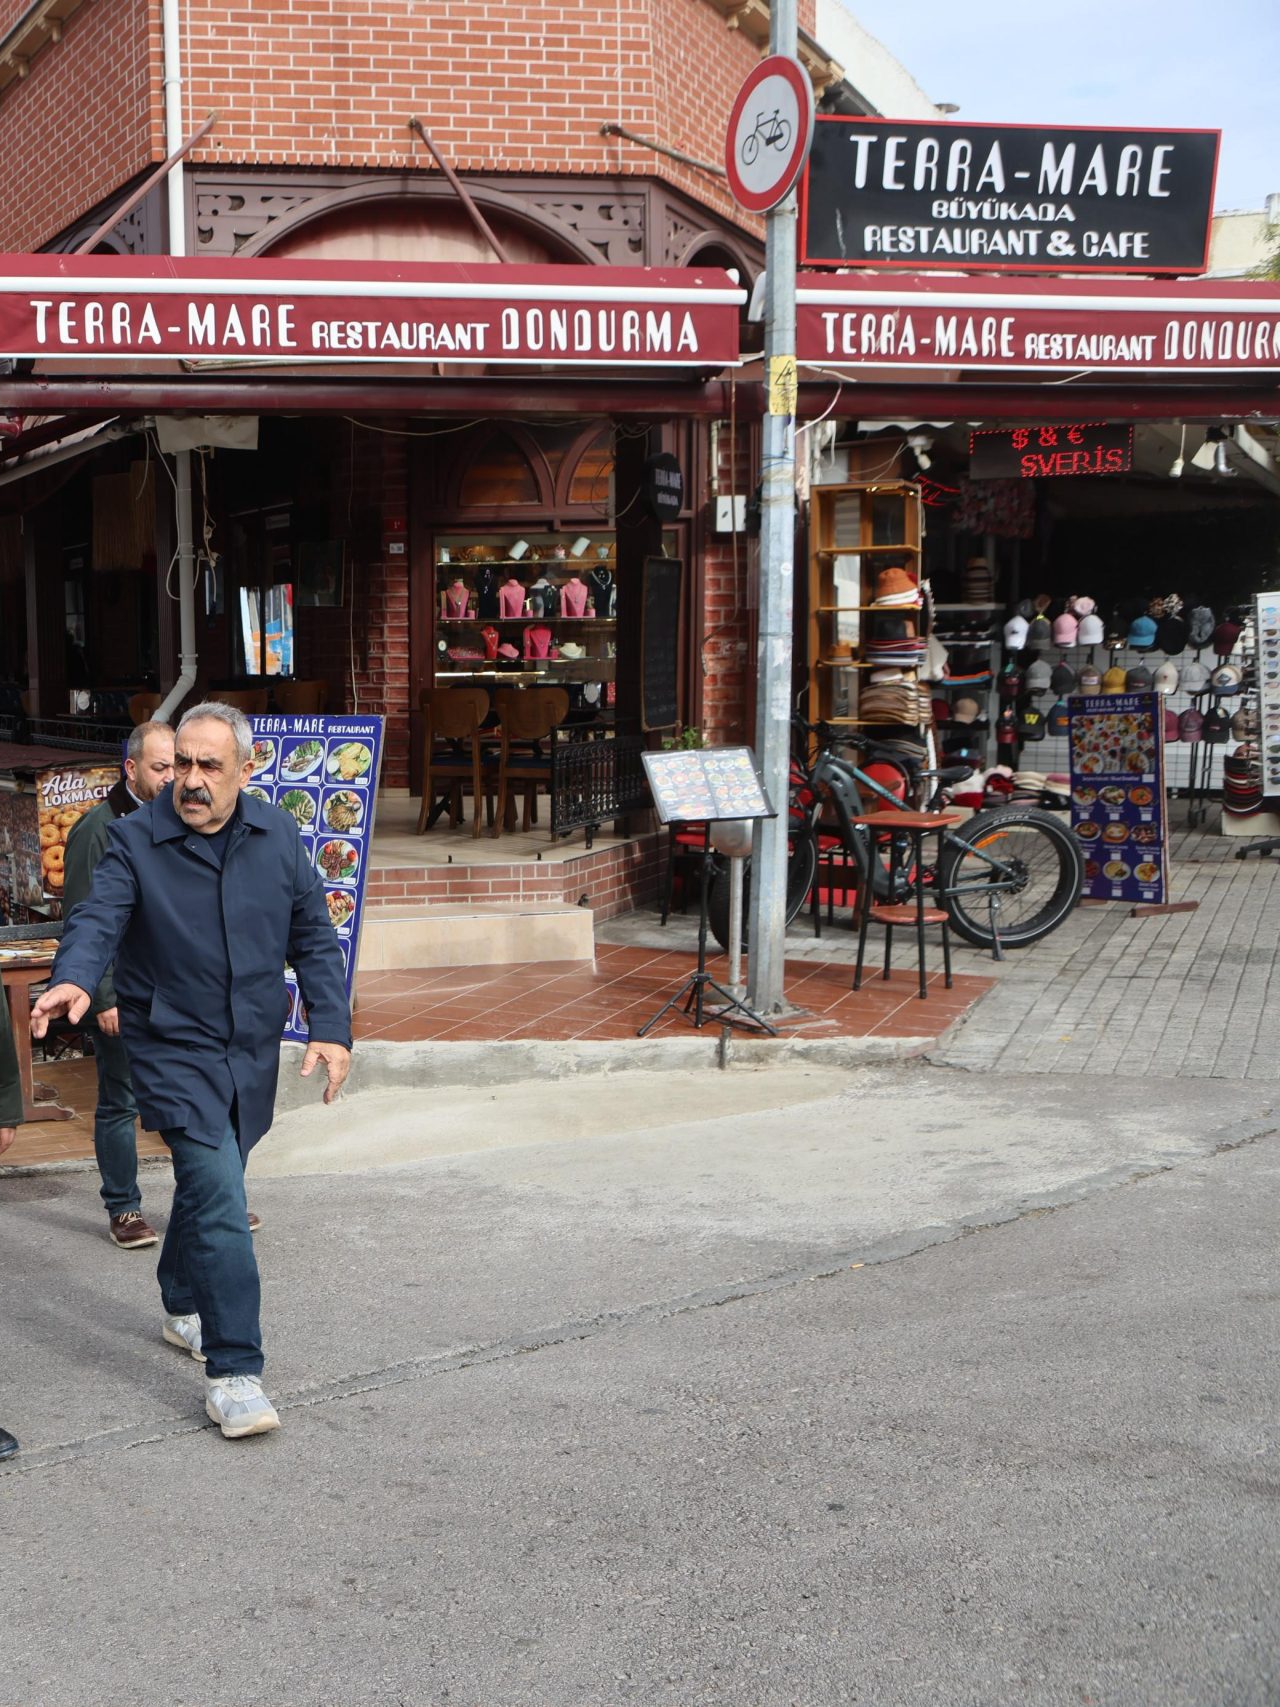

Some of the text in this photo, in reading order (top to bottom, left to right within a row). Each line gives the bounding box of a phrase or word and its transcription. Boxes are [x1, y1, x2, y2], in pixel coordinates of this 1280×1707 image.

[849, 134, 1175, 197] TERRA-MARE
[931, 197, 1076, 222] BÜYÜKADA
[864, 225, 1150, 259] RESTAURANT & CAFE
[30, 300, 700, 353] TERRA-MARE RESTAURANT DONDURMA
[821, 311, 1016, 358] TERRA-MARE
[1024, 333, 1157, 361] RESTAURANT
[253, 718, 375, 734] TERRA-MARE RESTAURANT
[41, 774, 86, 796] Ada
